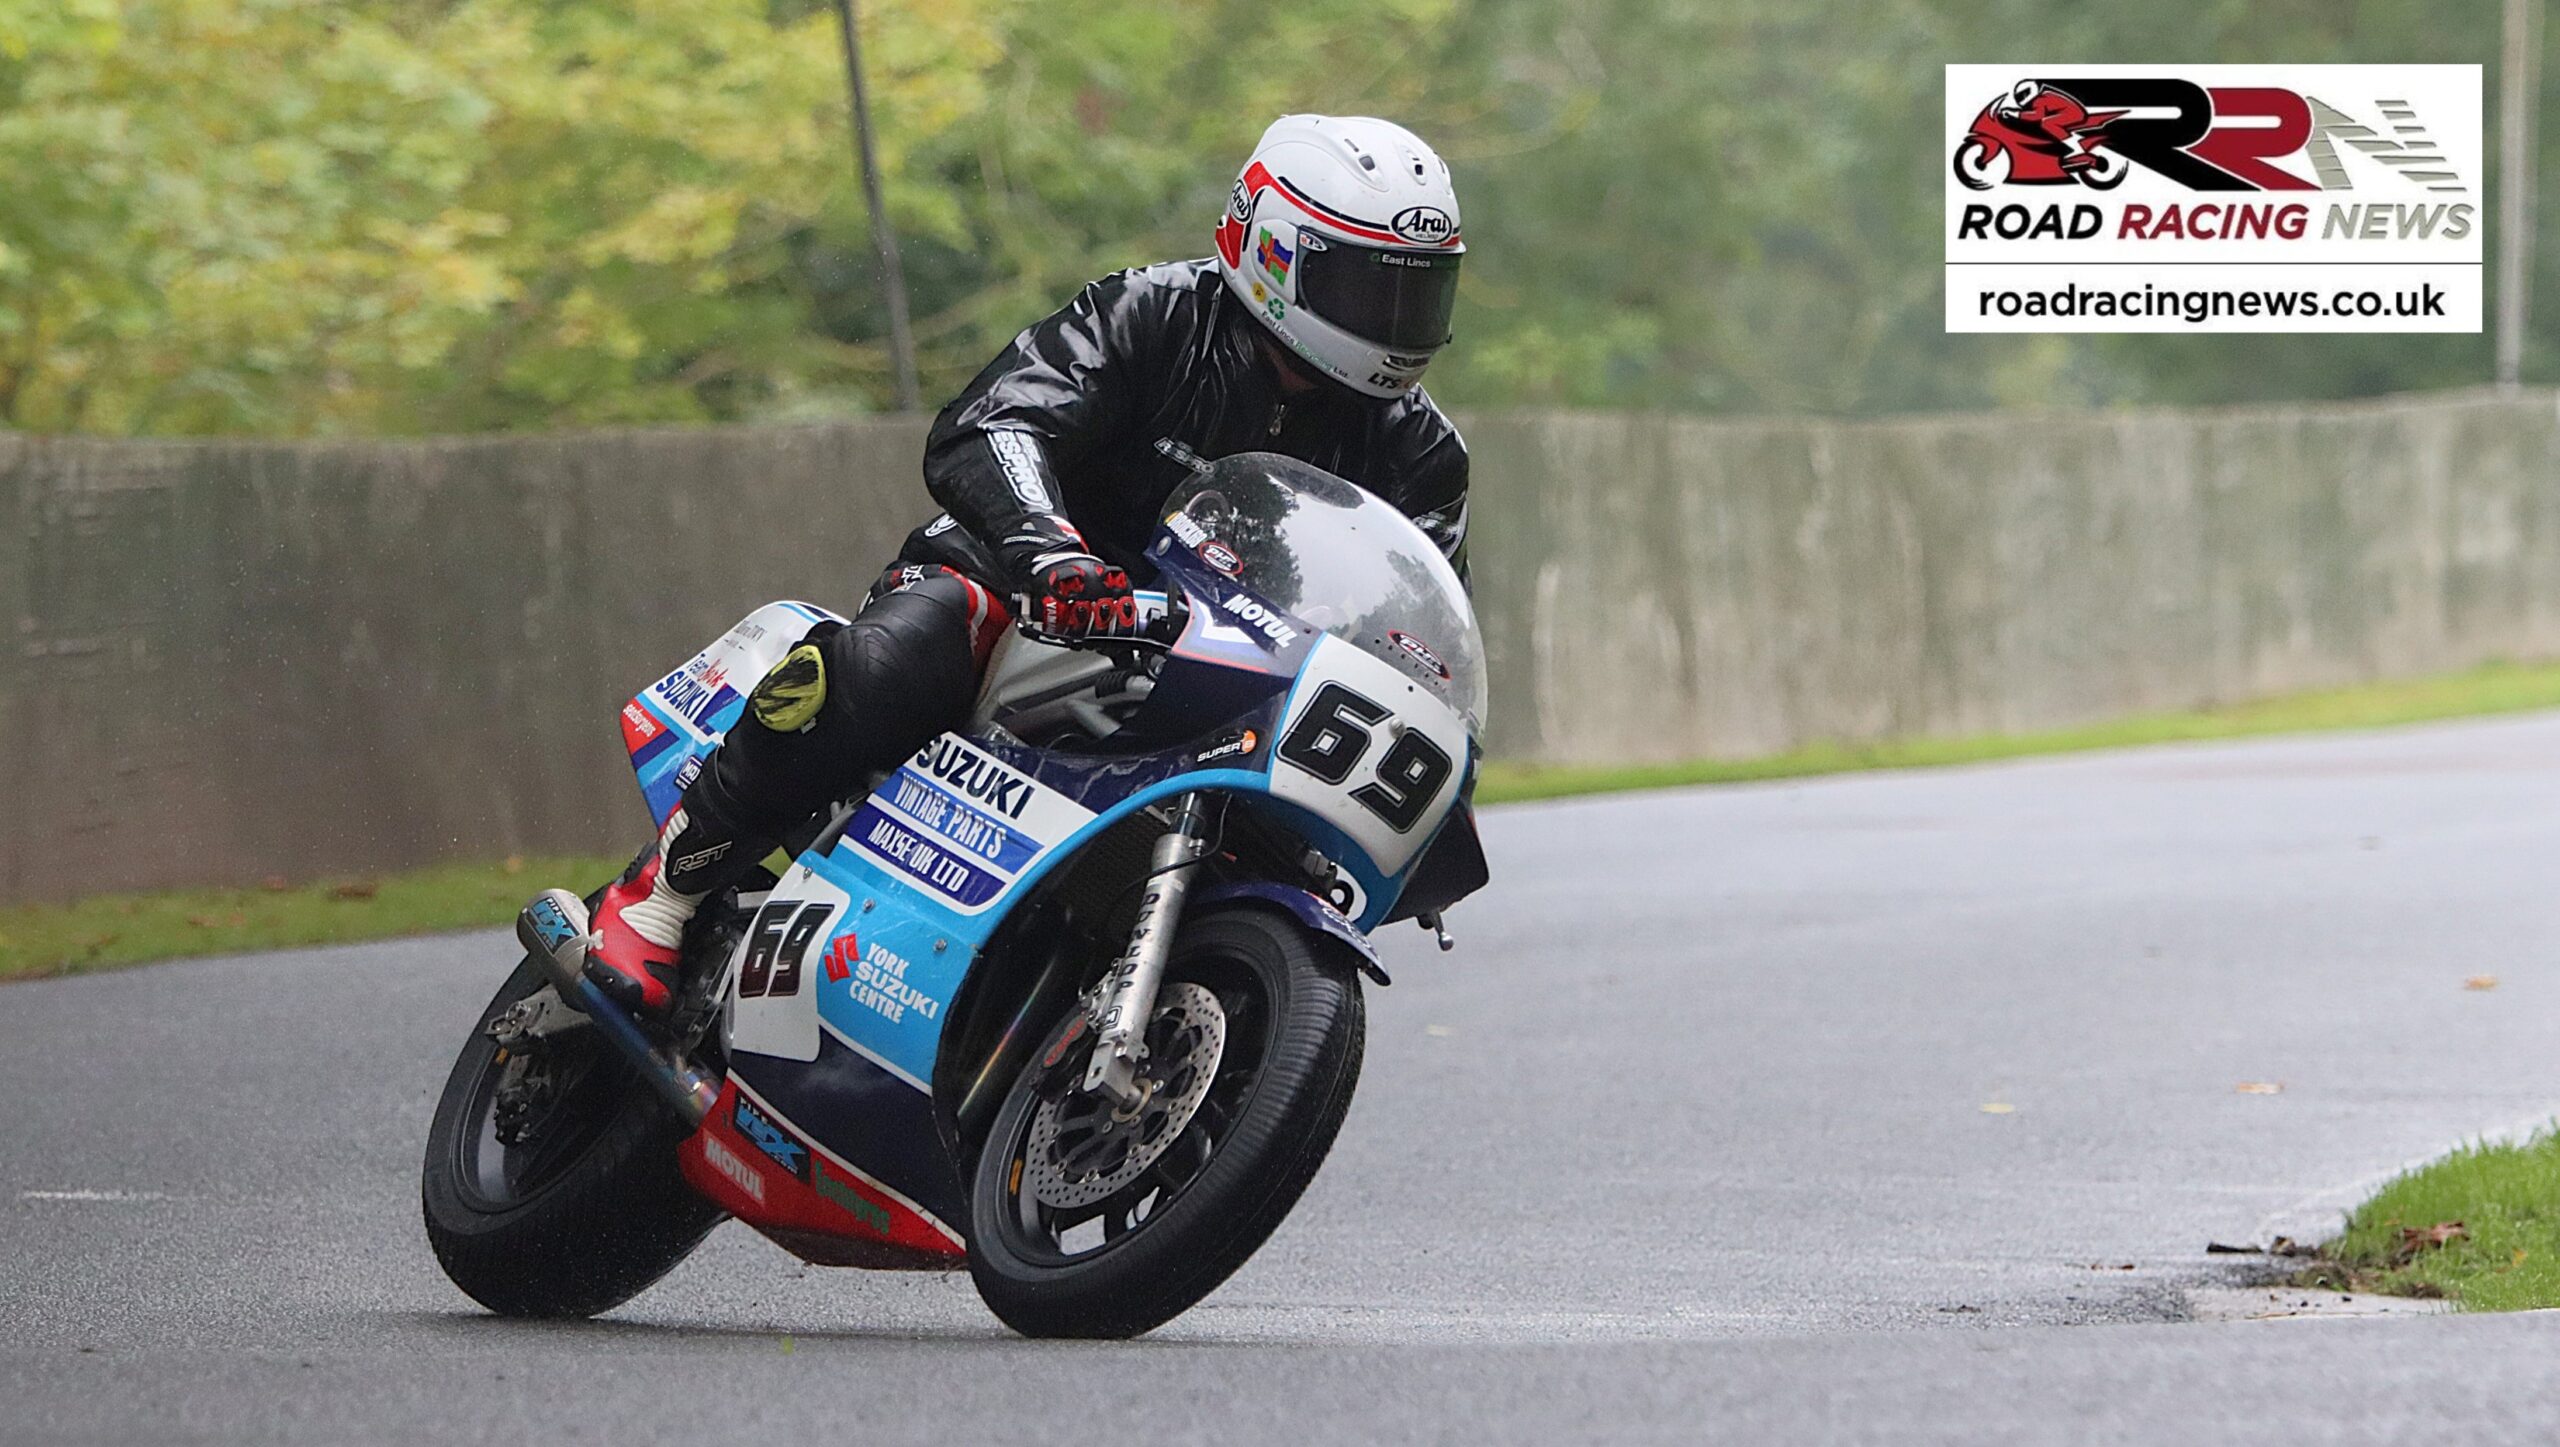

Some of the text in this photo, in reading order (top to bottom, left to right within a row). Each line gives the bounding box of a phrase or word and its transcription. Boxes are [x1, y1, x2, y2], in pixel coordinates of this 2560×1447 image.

[1231, 184, 1250, 215] Arai
[1397, 209, 1447, 233] Arai
[1382, 254, 1432, 268] East Lincs
[1222, 593, 1299, 648] MOTUL
[655, 670, 711, 724] SUZUKI
[1197, 741, 1240, 762] SUPER
[1276, 679, 1453, 834] 69
[917, 736, 1035, 820] SUZUKI
[894, 772, 1007, 859] VINTAGE PARTS
[672, 841, 732, 876] RST
[908, 844, 939, 875] UK
[931, 856, 969, 893] LTD
[738, 899, 835, 998] 69
[866, 942, 910, 979] YORK
[850, 979, 905, 1024] CENTRE
[855, 961, 939, 1020] SUZUKI
[705, 1137, 763, 1200] MOTUL
